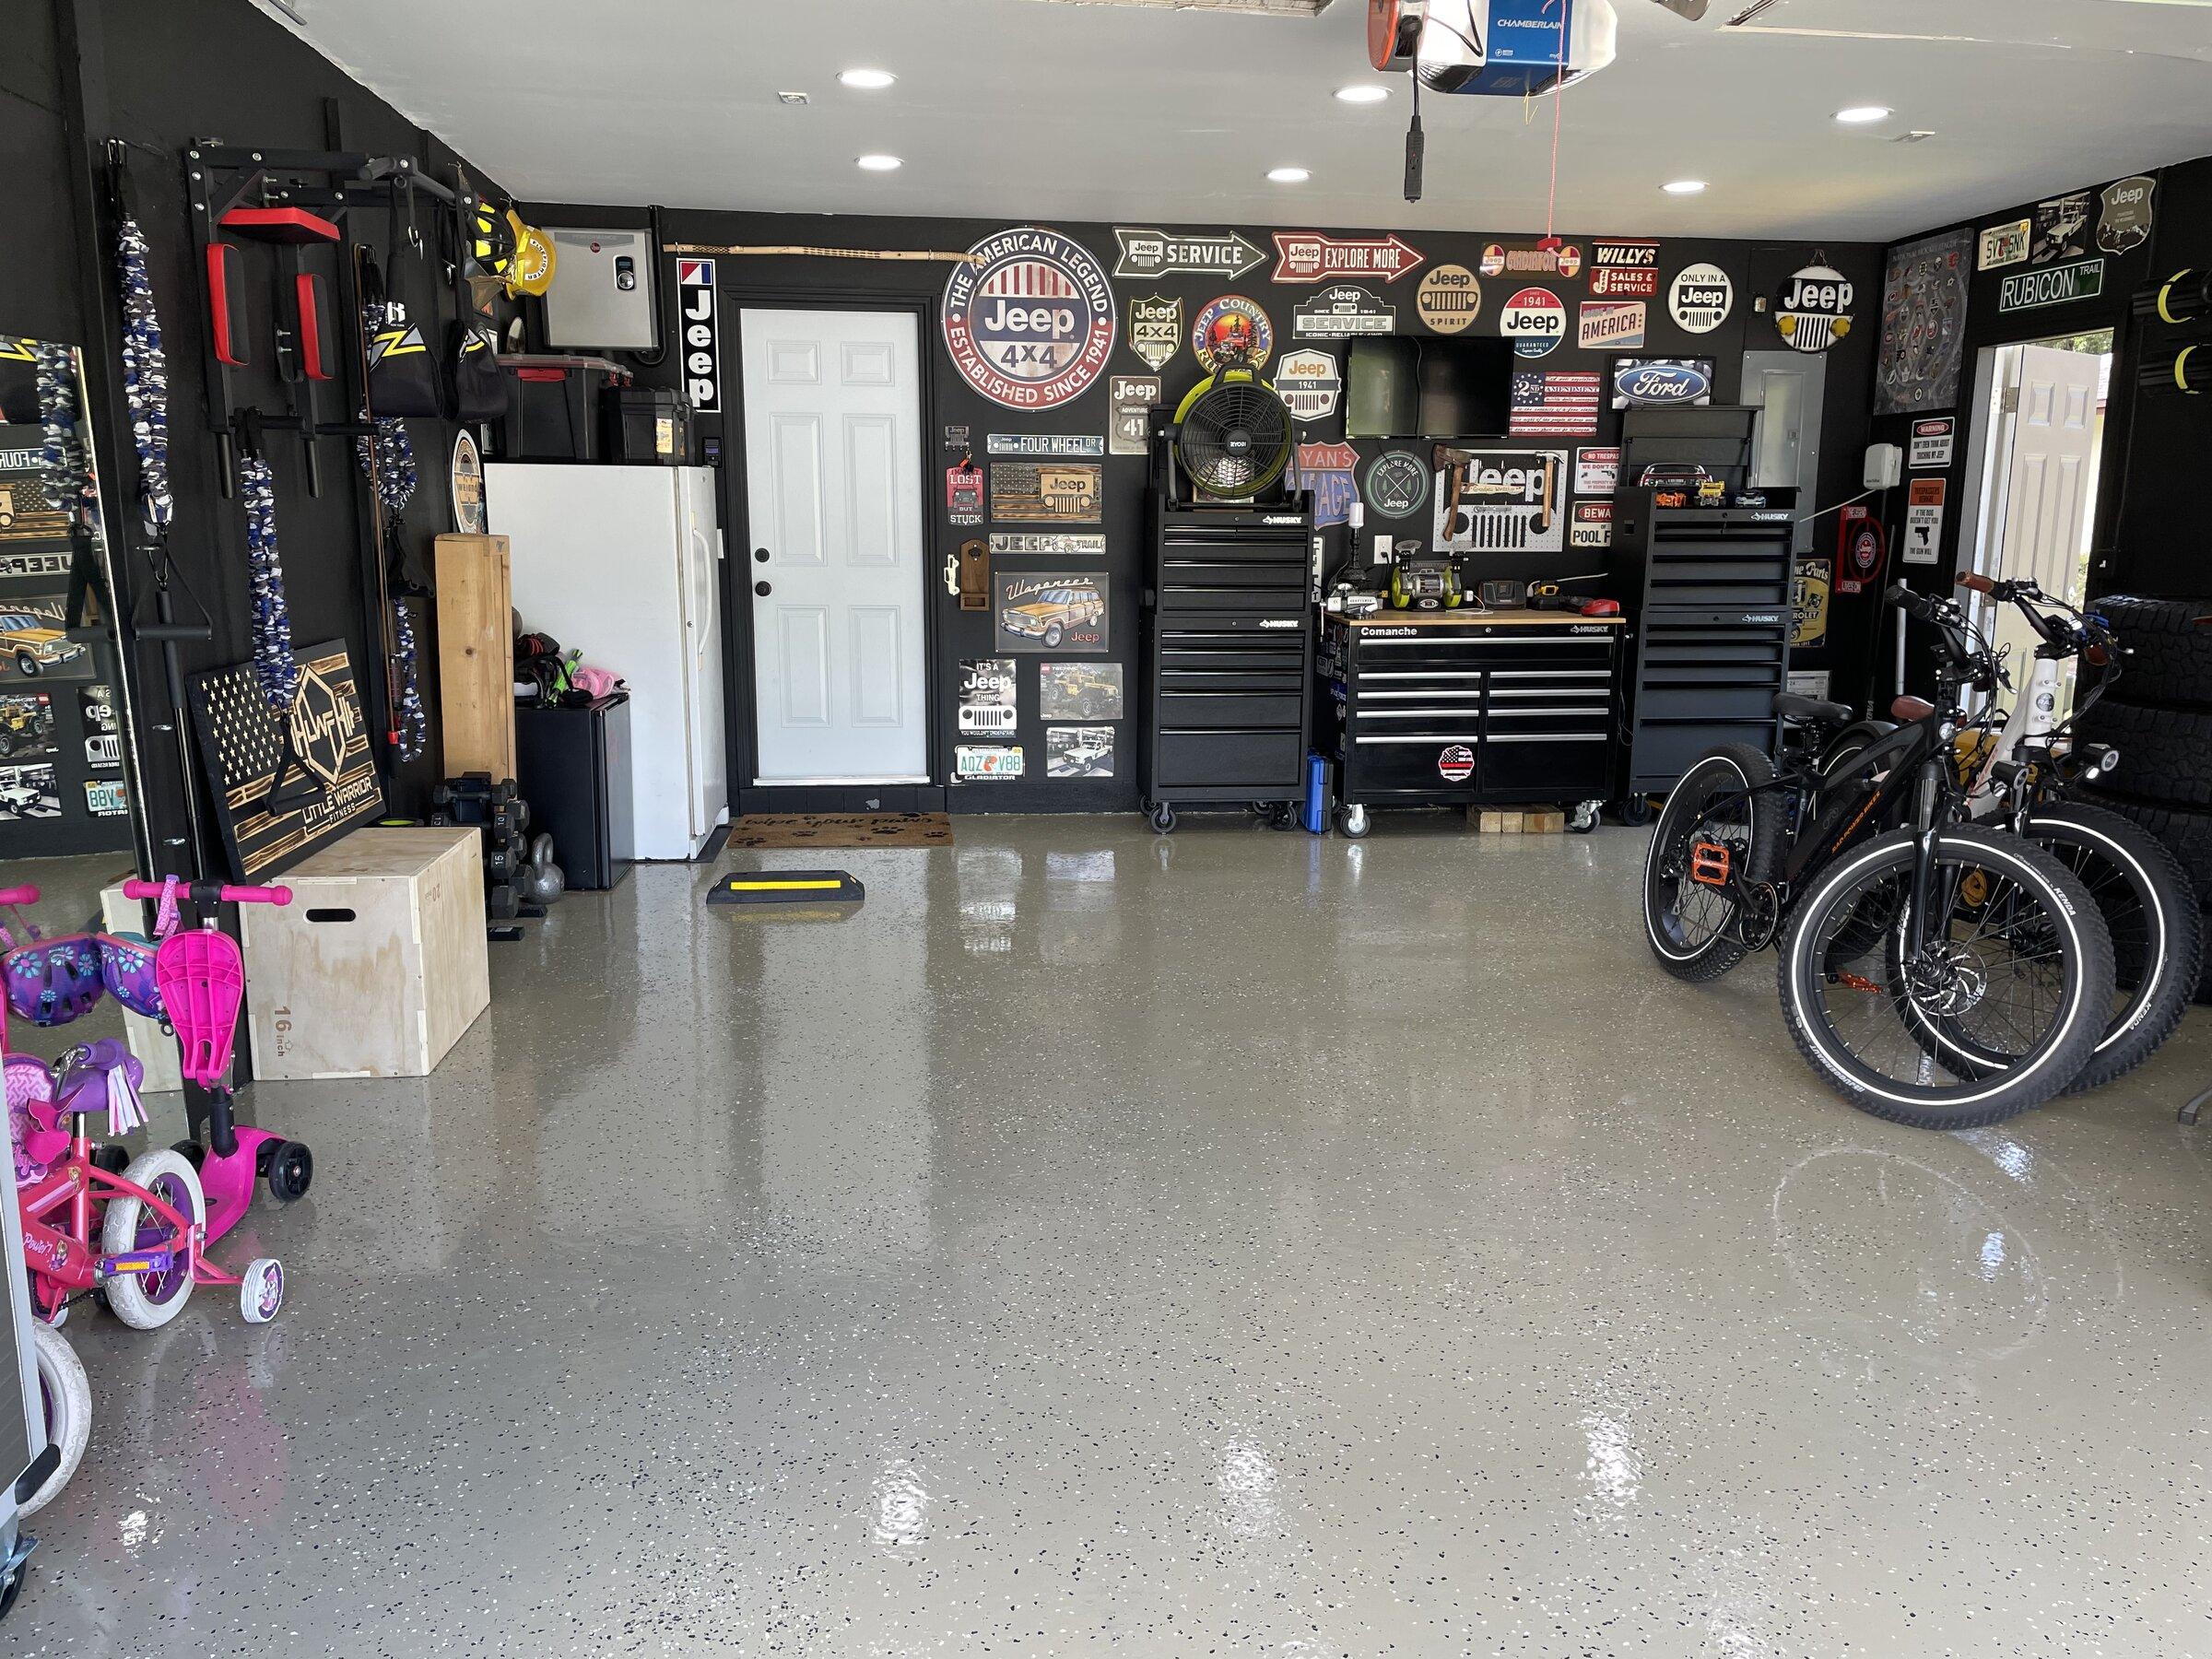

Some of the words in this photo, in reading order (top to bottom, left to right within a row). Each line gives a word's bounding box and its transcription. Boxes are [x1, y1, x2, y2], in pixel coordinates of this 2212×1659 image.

[1498, 19, 1562, 29] CHAMBERLAIN
[2112, 187, 2143, 205] Jeep
[1135, 242, 1159, 255] Jeep
[1167, 244, 1243, 265] SERVICE
[1290, 245, 1319, 258] Jeep
[1324, 248, 1369, 268] EXPLORE
[1373, 249, 1401, 268] MORE
[950, 274, 973, 307] THE
[970, 234, 1056, 272] AMERICAN
[1061, 247, 1108, 312] LEGEND
[1430, 270, 1470, 288] Jeep
[1611, 273, 1642, 281] SALES
[1646, 273, 1653, 281] &
[1681, 274, 1706, 283] ONLY
[1719, 275, 1726, 283] A
[1329, 288, 1360, 302] Jeep
[1610, 283, 1653, 292] SERVICE
[2003, 268, 2075, 308] RUBICON
[2079, 265, 2100, 276] TRAIL
[1524, 297, 1546, 306] 1941
[1681, 288, 1723, 306] Jeep
[1784, 279, 1853, 313] Jeep
[985, 300, 1075, 339] Jeep
[1135, 303, 1177, 322] Jeep
[1194, 308, 1214, 341] JEEP
[1219, 298, 1270, 341] COUNTRY
[1302, 318, 1386, 329] SERVICE
[1430, 318, 1466, 326] SPIRIT
[1507, 312, 1559, 334] Jeep
[1583, 313, 1636, 340] AMERICA
[686, 290, 714, 406] Jeep
[950, 326, 1038, 403] ESTABLISHED
[1045, 364, 1091, 401] SINCE
[1086, 329, 1109, 365] 1941
[1289, 360, 1326, 377] Jeep
[1114, 381, 1157, 400] Jeep
[1633, 371, 1688, 396] Ford
[1124, 419, 1143, 436] 41
[1021, 438, 1048, 452] FOUR
[1052, 438, 1084, 453] WHEEL
[1086, 439, 1096, 447] DR
[1290, 451, 1352, 468] YAN'S
[1377, 461, 1403, 477] EXPLORE
[1404, 461, 1418, 477] MORE
[950, 475, 982, 484] LOST
[1050, 478, 1086, 493] Jeep
[1384, 498, 1408, 509] Jeep
[950, 515, 982, 524] STUCK
[1584, 508, 1611, 518] BEWA
[996, 536, 1053, 551] JEEP
[1572, 530, 1601, 543] POOL
[1806, 561, 1829, 580] Parts
[1006, 577, 1094, 600] Wagoneer
[1793, 611, 1818, 619] ROLET
[1071, 631, 1100, 643] Jeep
[1360, 627, 1418, 636] Comanche
[976, 663, 991, 671] IT'S
[992, 663, 999, 671] A
[964, 673, 1011, 692] Jeep
[960, 756, 982, 771] AQZ
[999, 756, 1020, 771] V88
[301, 794, 335, 824] LITTLE
[335, 776, 372, 804] WARRIOR
[329, 803, 356, 823] FITNESS
[497, 817, 505, 826] 10
[495, 854, 504, 865] 15
[2053, 887, 2077, 916] KENDA
[275, 1006, 292, 1031] 16
[2128, 1001, 2152, 1030] KENDA
